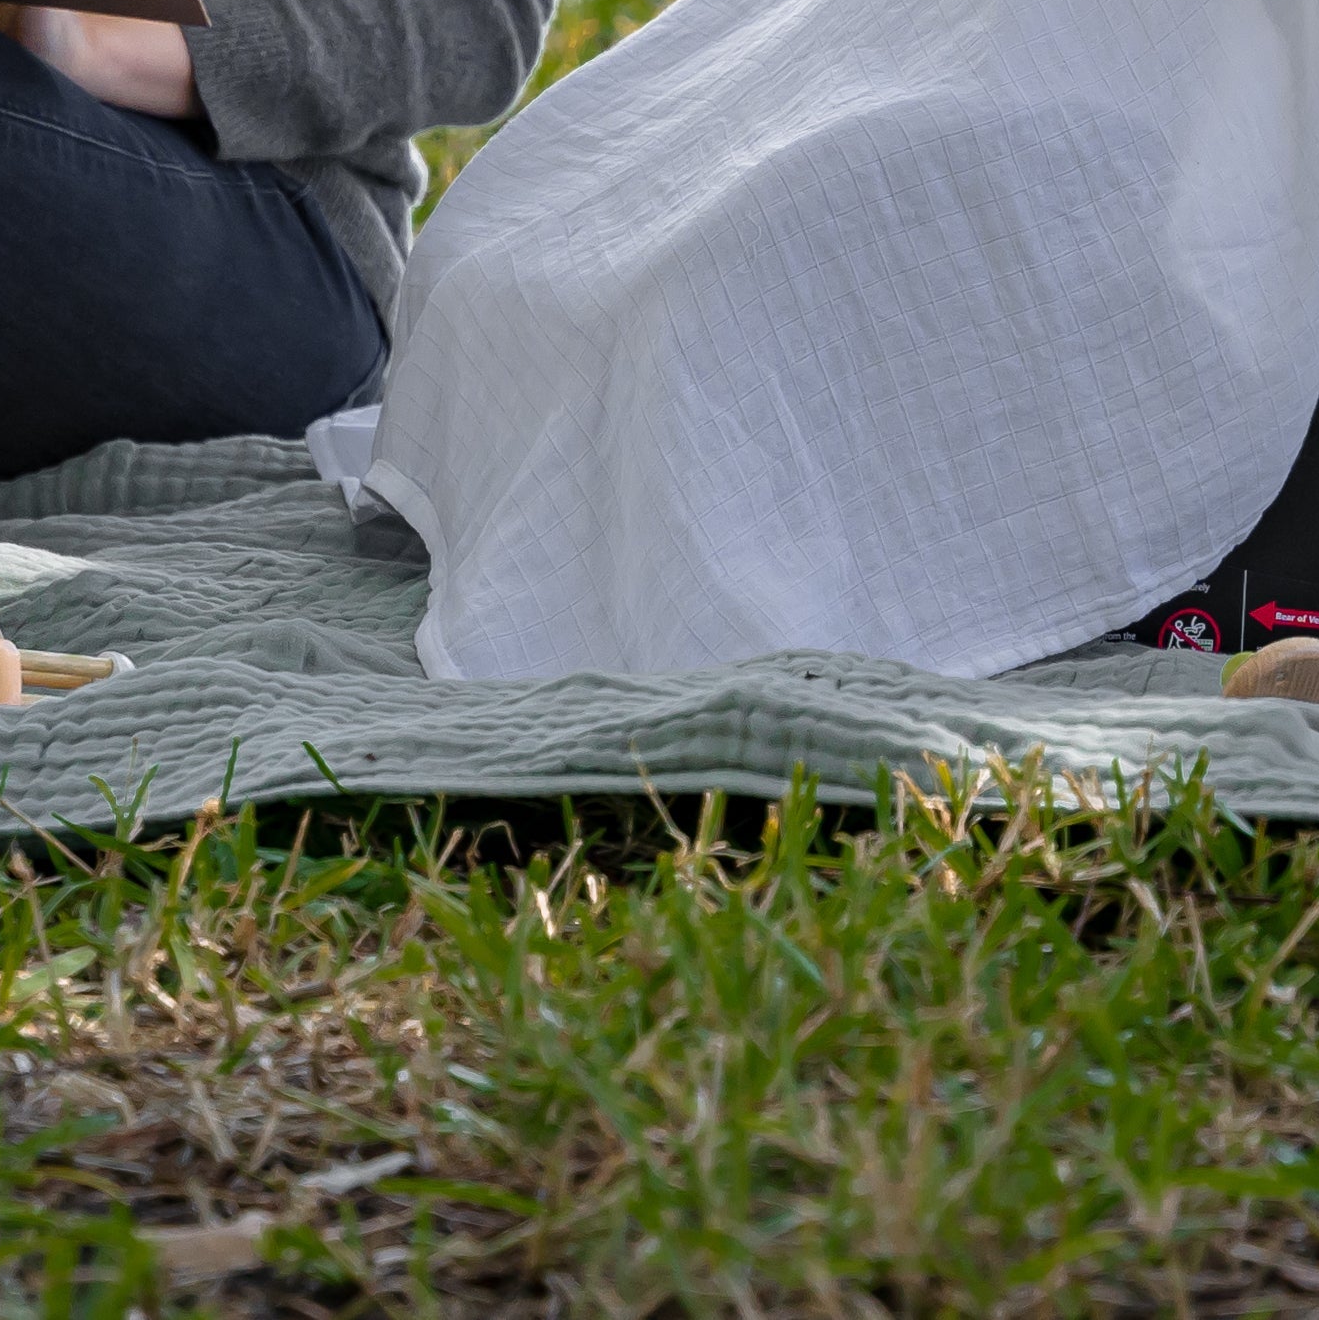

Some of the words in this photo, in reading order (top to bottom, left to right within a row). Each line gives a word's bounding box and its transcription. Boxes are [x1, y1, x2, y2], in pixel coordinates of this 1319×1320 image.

[1275, 612, 1295, 621] Rear
[1297, 614, 1307, 623] of
[1123, 632, 1136, 640] the
